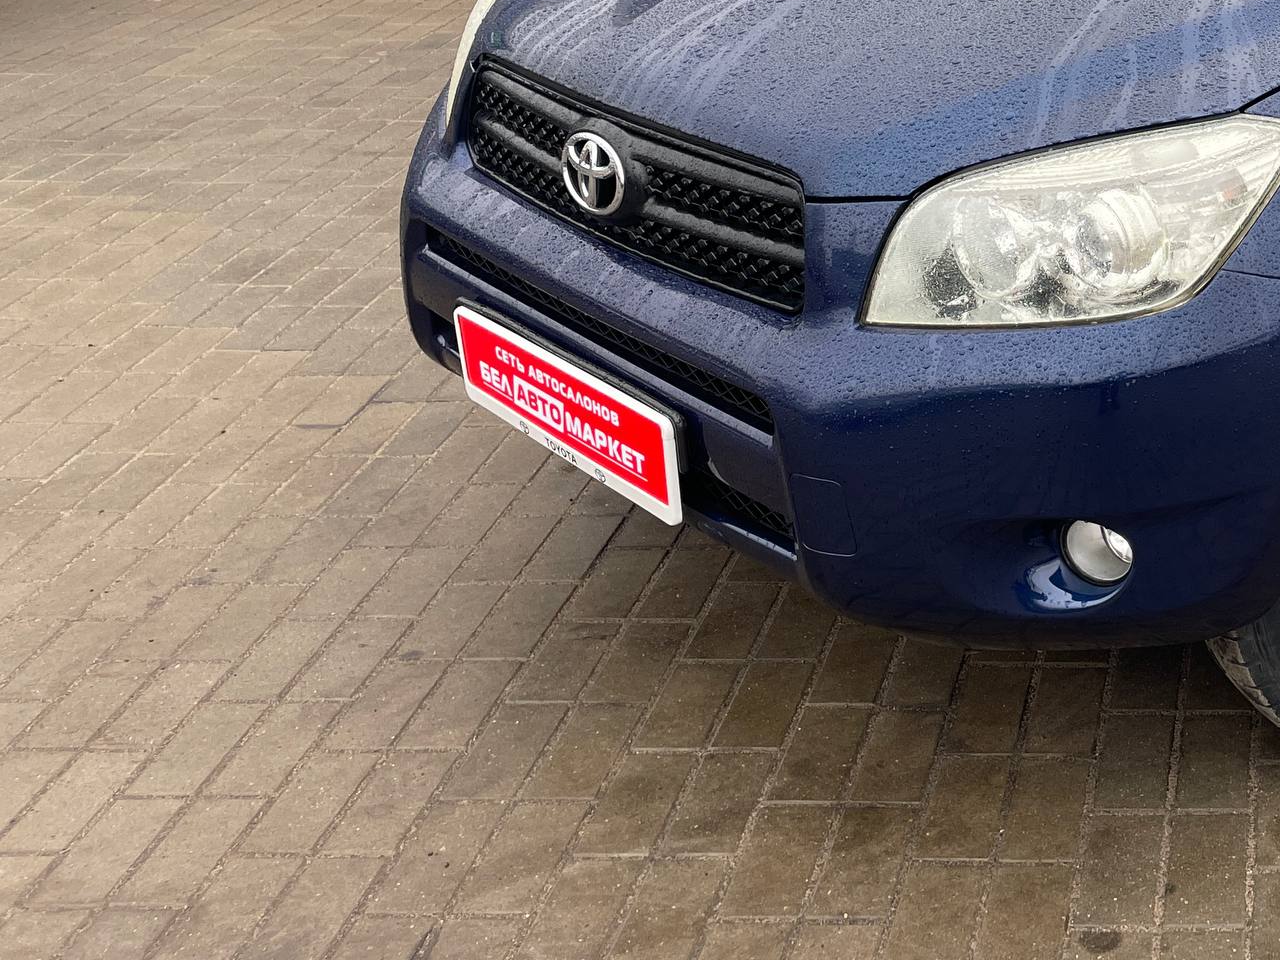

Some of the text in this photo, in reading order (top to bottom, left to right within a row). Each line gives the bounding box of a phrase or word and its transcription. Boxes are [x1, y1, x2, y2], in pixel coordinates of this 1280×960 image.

[479, 360, 646, 475] БЕЛ АВТО МАРКЕТ
[494, 346, 620, 427] СЕТЬ АВТОСАЛОНОВ
[544, 436, 578, 466] TOYOTA
